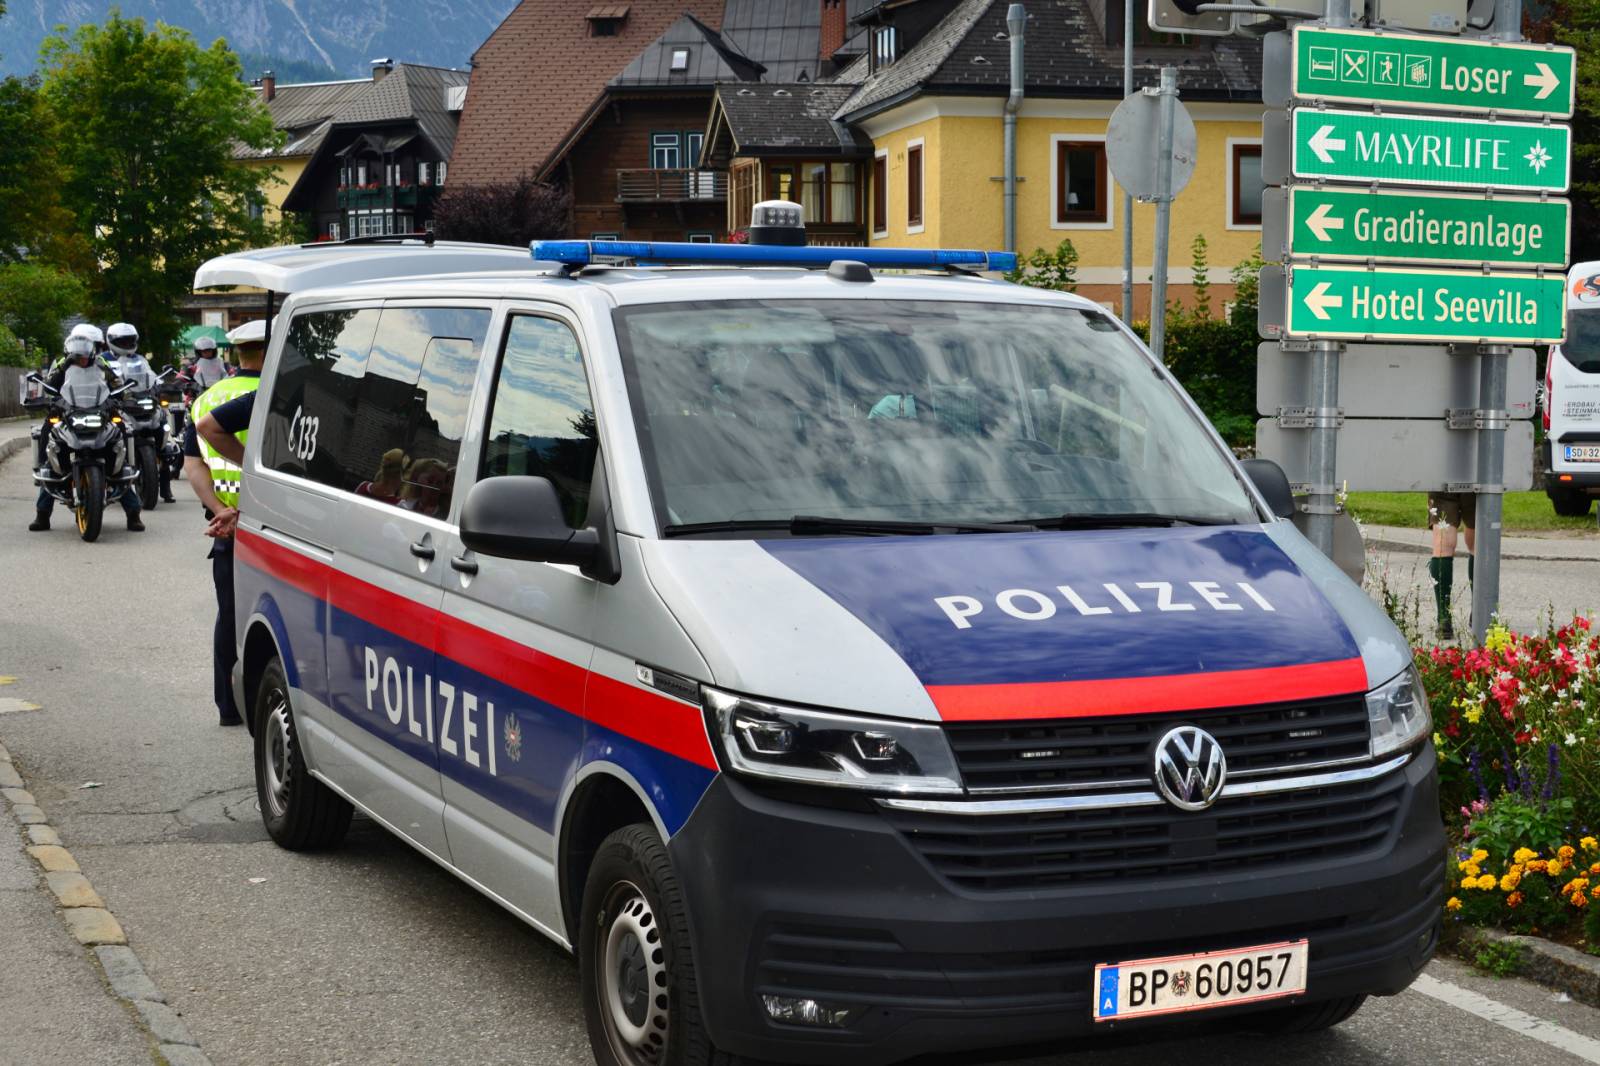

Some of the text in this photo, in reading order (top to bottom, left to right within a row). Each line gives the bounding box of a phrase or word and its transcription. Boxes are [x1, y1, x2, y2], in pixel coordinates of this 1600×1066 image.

[1440, 57, 1512, 95] Loser
[1355, 130, 1510, 171] MAYRLIFE
[1354, 208, 1543, 256] Gradieranlage
[1352, 286, 1537, 325] Hotel Seevilla
[297, 416, 319, 460] 133
[1571, 448, 1582, 457] SD
[933, 581, 1276, 629] POLIZEI
[364, 646, 496, 777] POLIZEI
[1129, 953, 1292, 1006] BP 60957
[1103, 998, 1113, 1010] A
